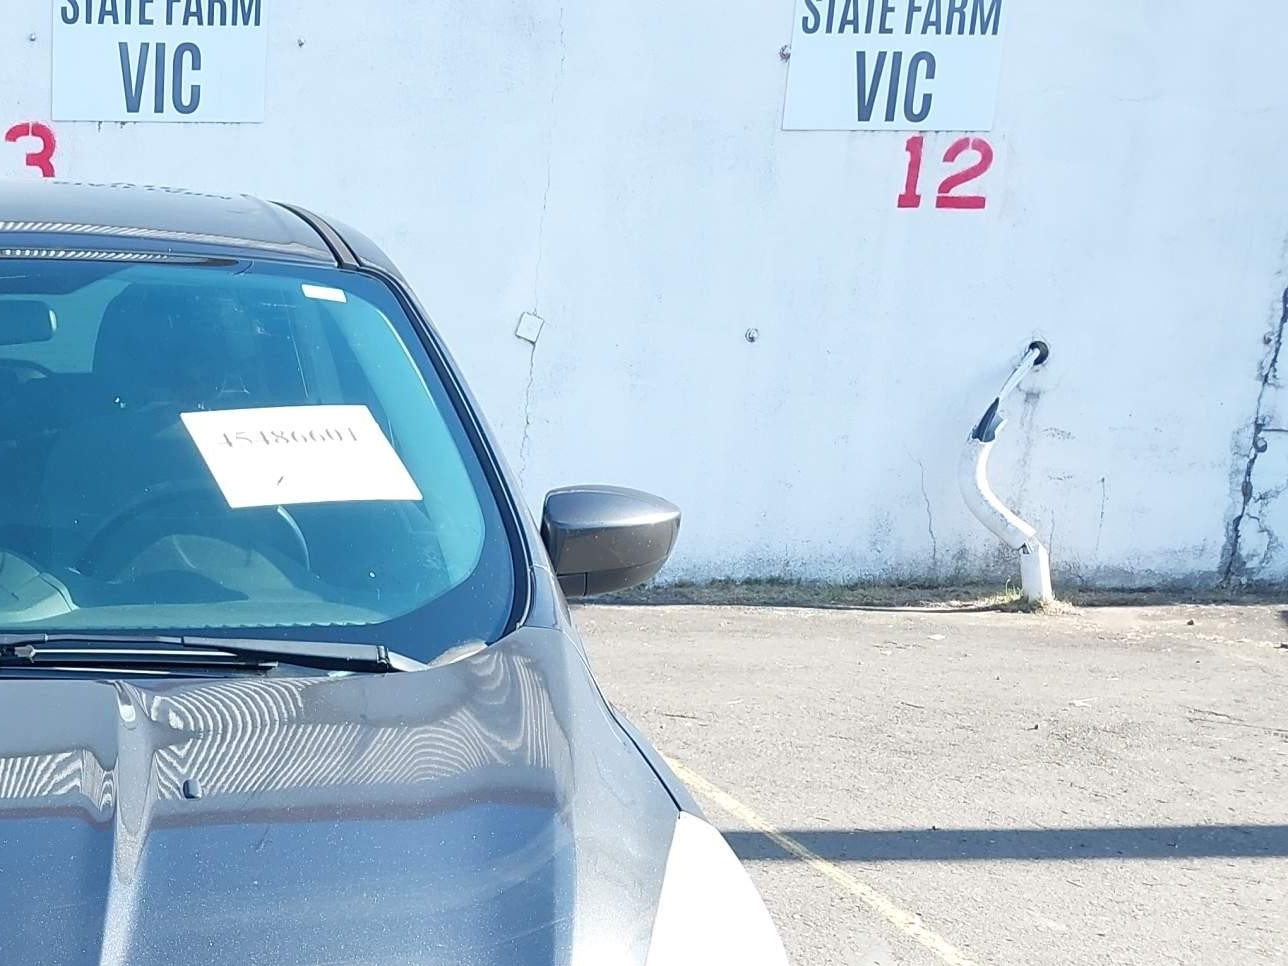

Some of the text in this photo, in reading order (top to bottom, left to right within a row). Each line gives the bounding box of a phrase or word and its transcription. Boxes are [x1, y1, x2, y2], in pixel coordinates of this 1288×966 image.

[801, 0, 1002, 36] STATE FARM
[118, 42, 201, 114] VIC
[856, 51, 936, 122] VIC
[897, 136, 993, 209] 12
